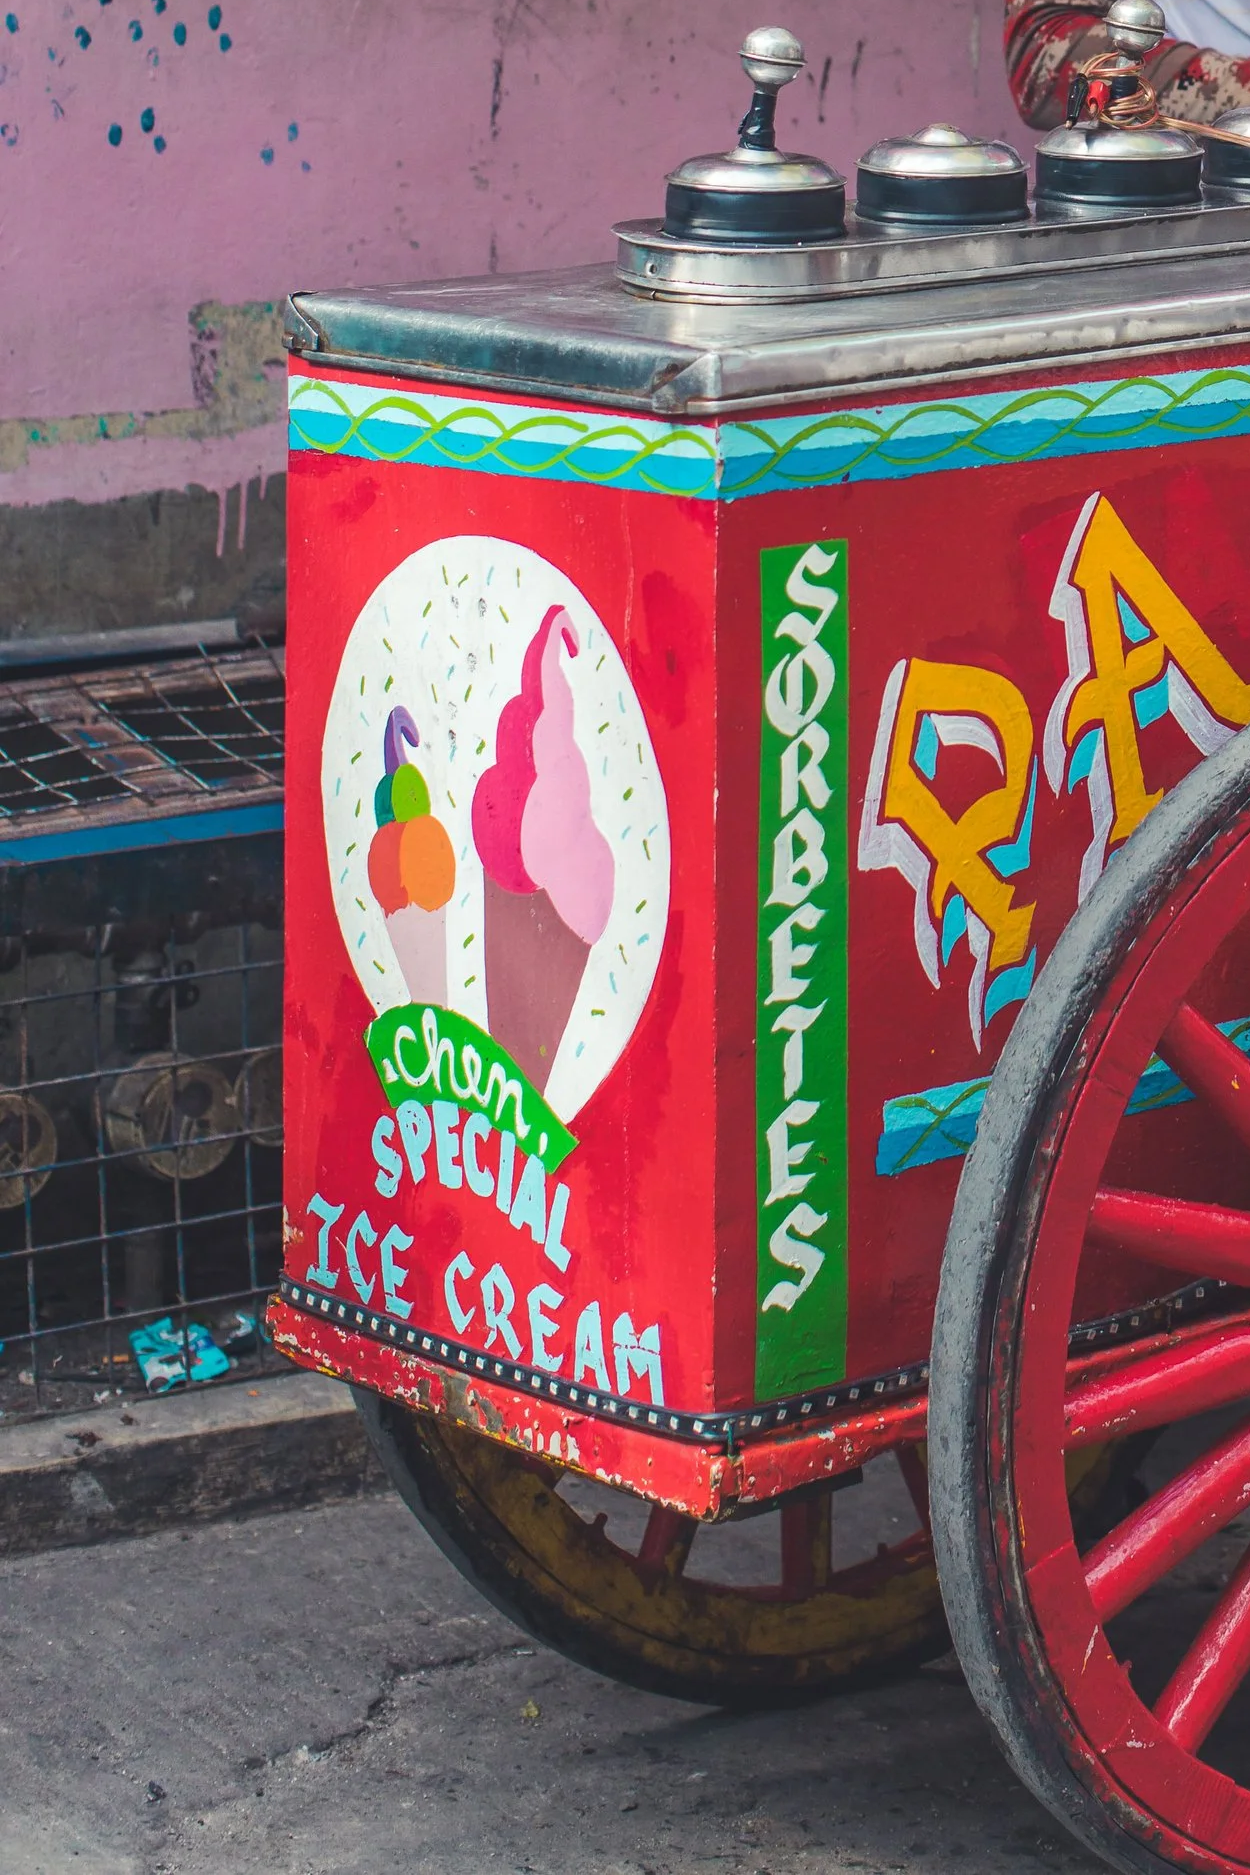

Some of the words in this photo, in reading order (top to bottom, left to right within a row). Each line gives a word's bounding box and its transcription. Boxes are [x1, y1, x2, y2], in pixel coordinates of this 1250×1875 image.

[761, 543, 839, 1314] SORBETES
[372, 1100, 571, 1273] SPECIAL
[306, 1192, 414, 1319] ICE
[444, 1251, 664, 1407] CREAM
